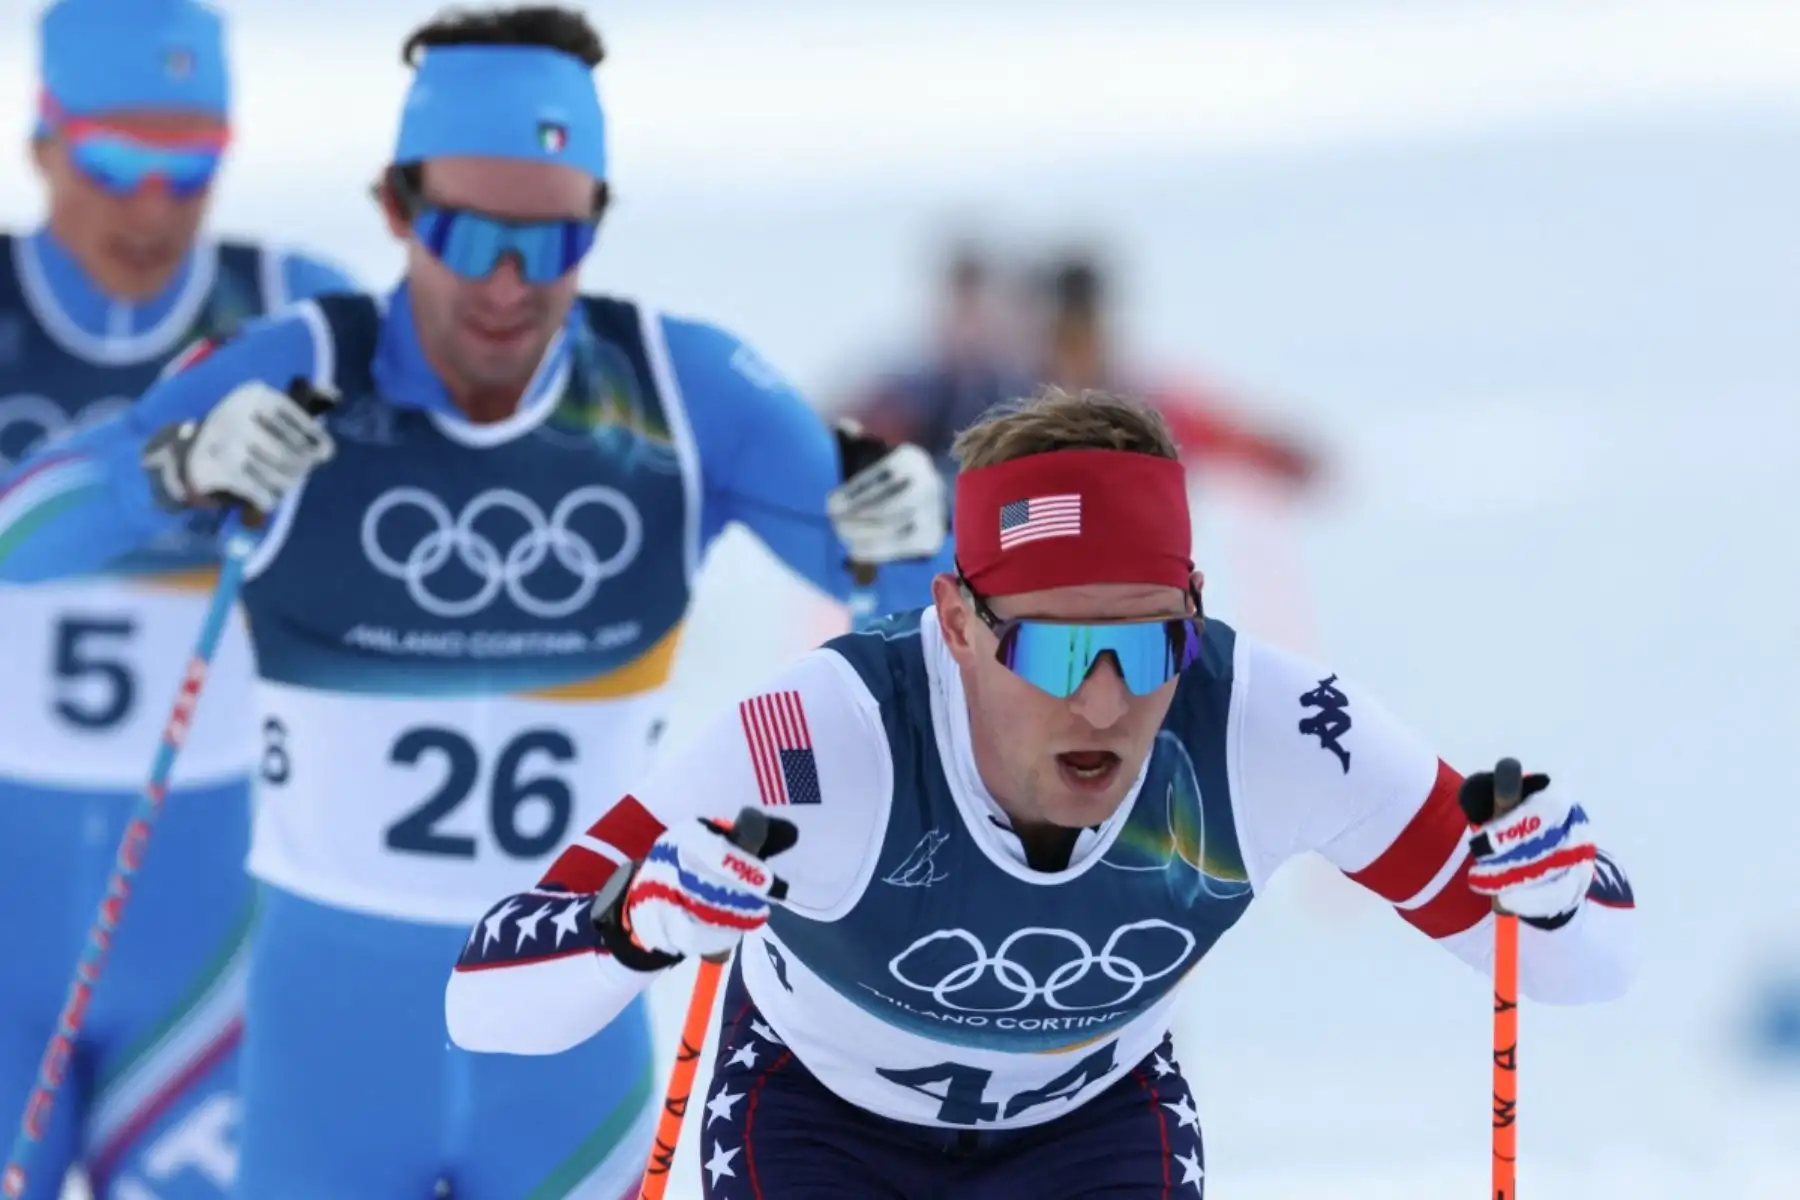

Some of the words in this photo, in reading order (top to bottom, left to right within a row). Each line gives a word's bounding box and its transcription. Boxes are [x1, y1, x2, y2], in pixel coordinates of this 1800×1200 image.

[54, 614, 138, 732] 5
[384, 726, 578, 860] 26
[875, 1038, 1119, 1125] 44
